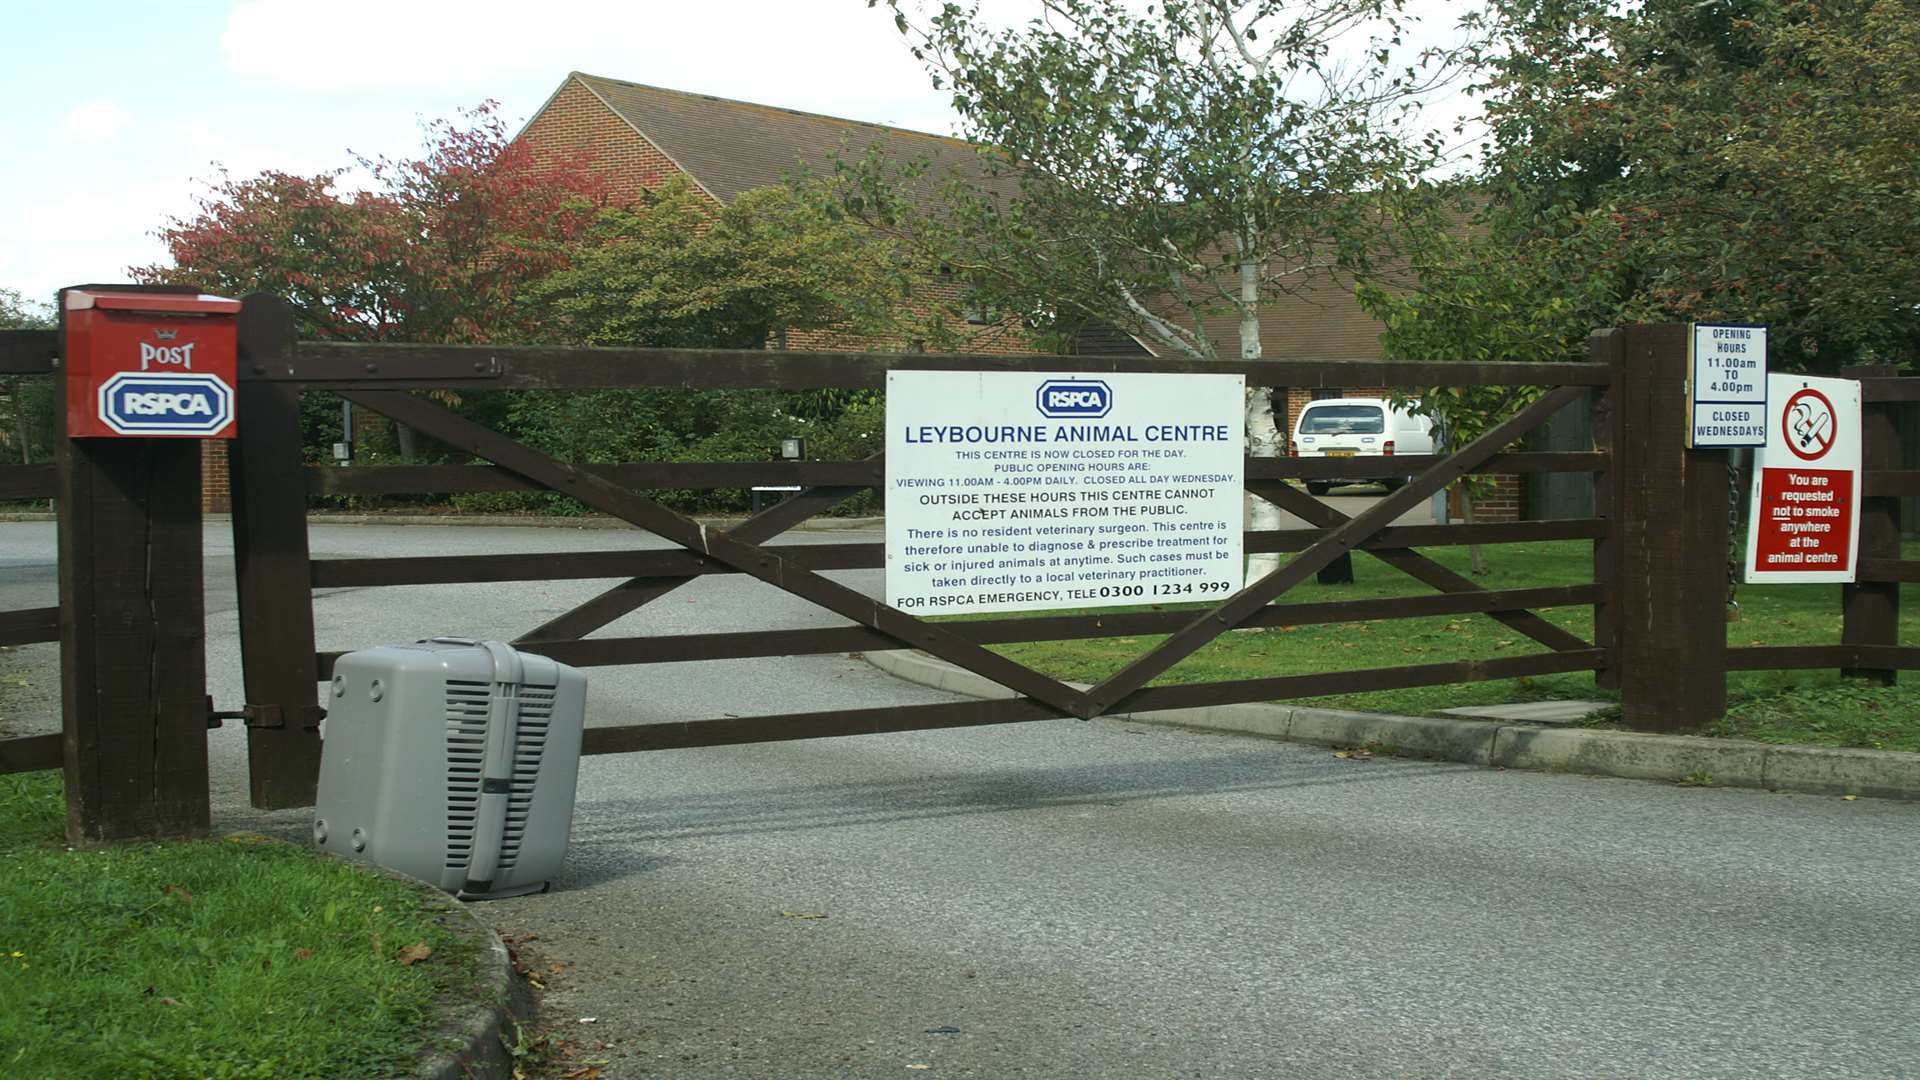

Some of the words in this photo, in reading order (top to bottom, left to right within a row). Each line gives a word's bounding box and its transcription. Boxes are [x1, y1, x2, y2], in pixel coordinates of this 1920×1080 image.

[1713, 329, 1751, 339] OPENING
[1717, 343, 1747, 353] HOURS
[140, 342, 194, 370] POST
[1707, 359, 1756, 368] 11.00am
[1725, 370, 1738, 379] TO
[1710, 382, 1753, 393] 4.00pm
[124, 393, 212, 415] RSPCA
[1049, 392, 1102, 407] RSPCA
[1712, 411, 1750, 421] CLOSED
[906, 426, 1047, 443] LEYBOURNE
[1054, 426, 1138, 442] ANIMAL
[1145, 426, 1228, 441] CENTRE
[1697, 426, 1764, 436] WEDNESDAYS
[956, 451, 981, 460] THIS
[984, 451, 1027, 459] CENTRE
[1031, 451, 1041, 459] IS
[1073, 450, 1115, 458] CLOSED
[1118, 450, 1138, 458] FOR
[994, 464, 1033, 472] PUBLIC
[1088, 463, 1125, 471] HOURS
[1128, 463, 1150, 471] ARE:
[896, 478, 945, 487] VIEWING
[949, 478, 993, 486] 11.00AM
[1003, 477, 1041, 485] 4.00PM
[1083, 476, 1126, 484] CLOSED
[1172, 475, 1236, 483] WEDNESDAY.
[1789, 474, 1808, 485] You
[1810, 477, 1828, 485] are
[920, 494, 979, 505] OUTSIDE
[984, 493, 1026, 503] THESE
[1031, 492, 1076, 501] HOURS
[1080, 491, 1109, 501] THIS
[1112, 490, 1161, 500] CENTRE
[1165, 489, 1215, 499] CANNOT
[1781, 490, 1834, 504] requested
[952, 509, 1006, 520] ACCEPT
[1010, 508, 1068, 519] ANIMALS
[1072, 507, 1109, 517] FROM
[1113, 506, 1136, 515] THE
[1141, 505, 1187, 515] PUBLIC.
[1773, 506, 1791, 518] not
[1792, 508, 1803, 517] to
[1806, 507, 1840, 517] smoke
[907, 529, 943, 538] There
[948, 528, 958, 537] is
[963, 529, 978, 537] no
[982, 526, 1032, 536] resident
[1036, 525, 1094, 536] veterinary
[1099, 524, 1149, 535] surgeon.
[1153, 522, 1176, 531] This
[1180, 521, 1214, 530] centre
[1217, 521, 1226, 529] is
[1781, 522, 1830, 536] anywhere
[905, 545, 963, 555] therefore
[967, 544, 1009, 553] unable
[1013, 543, 1024, 551] to
[1029, 541, 1083, 553] diagnose
[1087, 540, 1095, 549] &
[1100, 538, 1153, 551] prescribe
[1157, 537, 1210, 547] treatment
[1213, 536, 1228, 545] for
[1790, 538, 1802, 548] at
[1804, 537, 1819, 547] the
[904, 562, 929, 572] sick
[951, 560, 994, 572] injured
[999, 558, 1045, 568] animals
[1050, 558, 1060, 566] at
[1064, 554, 1113, 567] anytime.
[1117, 554, 1146, 563] Such
[1150, 554, 1182, 562] cases
[1186, 552, 1212, 560] must
[1216, 551, 1229, 559] be
[1768, 552, 1804, 563] animal
[1805, 553, 1838, 563] centre
[932, 577, 966, 587] taken
[971, 575, 1016, 587] directly
[1020, 575, 1031, 583] to
[1046, 572, 1074, 581] local
[1078, 570, 1136, 581] veterinary
[1139, 567, 1206, 579] practitioner.
[897, 597, 925, 608] FOR
[929, 596, 975, 606] RSPCA
[979, 591, 1063, 604] EMERGENCY,
[1068, 589, 1096, 599] TELE
[1100, 585, 1143, 597] 0300
[1153, 583, 1193, 595] 1234
[1200, 582, 1230, 593] 999
